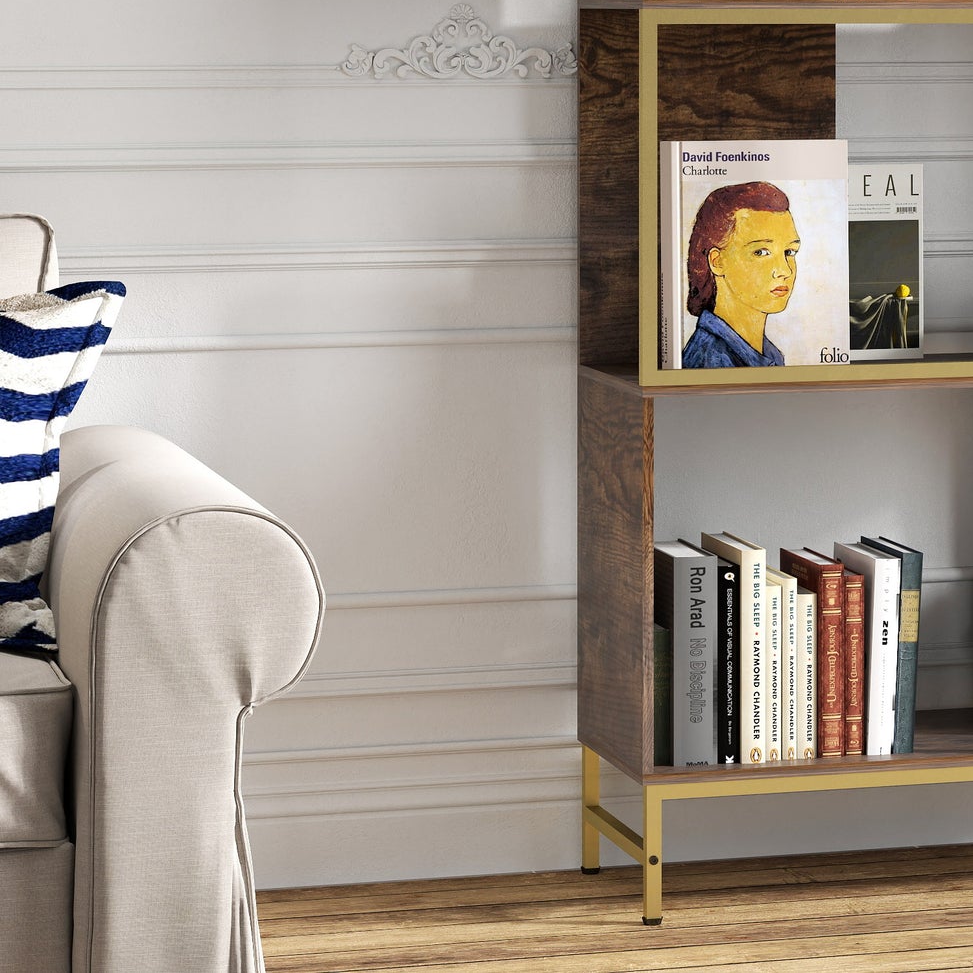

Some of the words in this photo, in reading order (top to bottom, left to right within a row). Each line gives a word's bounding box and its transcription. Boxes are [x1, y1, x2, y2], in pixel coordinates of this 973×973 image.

[681, 151, 713, 163] David
[715, 151, 771, 163] Foenkinos
[681, 165, 728, 177] Charlotte
[863, 174, 920, 197] EAL
[819, 347, 849, 364] folio
[690, 566, 706, 594] Ron
[690, 598, 706, 629] Arad
[726, 627, 733, 637] OF
[881, 620, 889, 646] zen
[689, 638, 707, 657] No
[752, 640, 760, 687] RAYMOND
[686, 660, 707, 724] Discipline
[752, 691, 760, 740] CHANDLER
